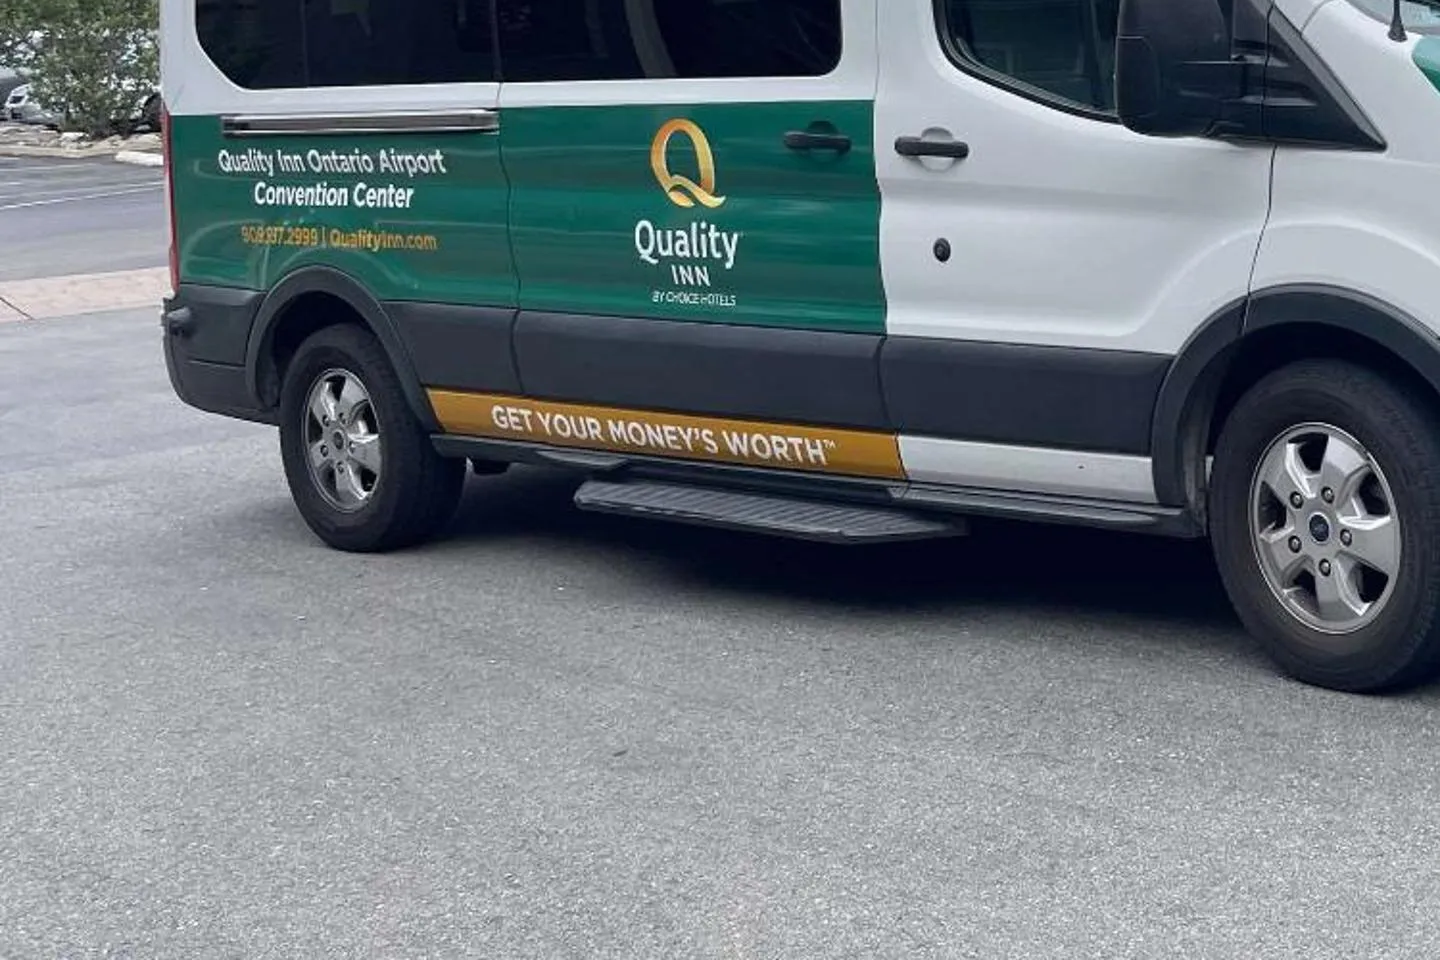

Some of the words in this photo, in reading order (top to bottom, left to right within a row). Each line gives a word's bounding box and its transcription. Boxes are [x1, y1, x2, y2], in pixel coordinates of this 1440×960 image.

[218, 148, 274, 177] Quality
[277, 149, 306, 172] Inn
[307, 148, 374, 173] Ontario
[379, 148, 447, 177] Airport
[651, 118, 726, 208] Q
[254, 181, 348, 207] Convention
[353, 182, 415, 208] Center
[634, 219, 739, 270] Quality
[671, 264, 711, 287] INN
[701, 293, 737, 306] HOTELS
[491, 405, 533, 432] GET
[536, 412, 602, 441] YOUR
[608, 420, 720, 455] MONEY'S
